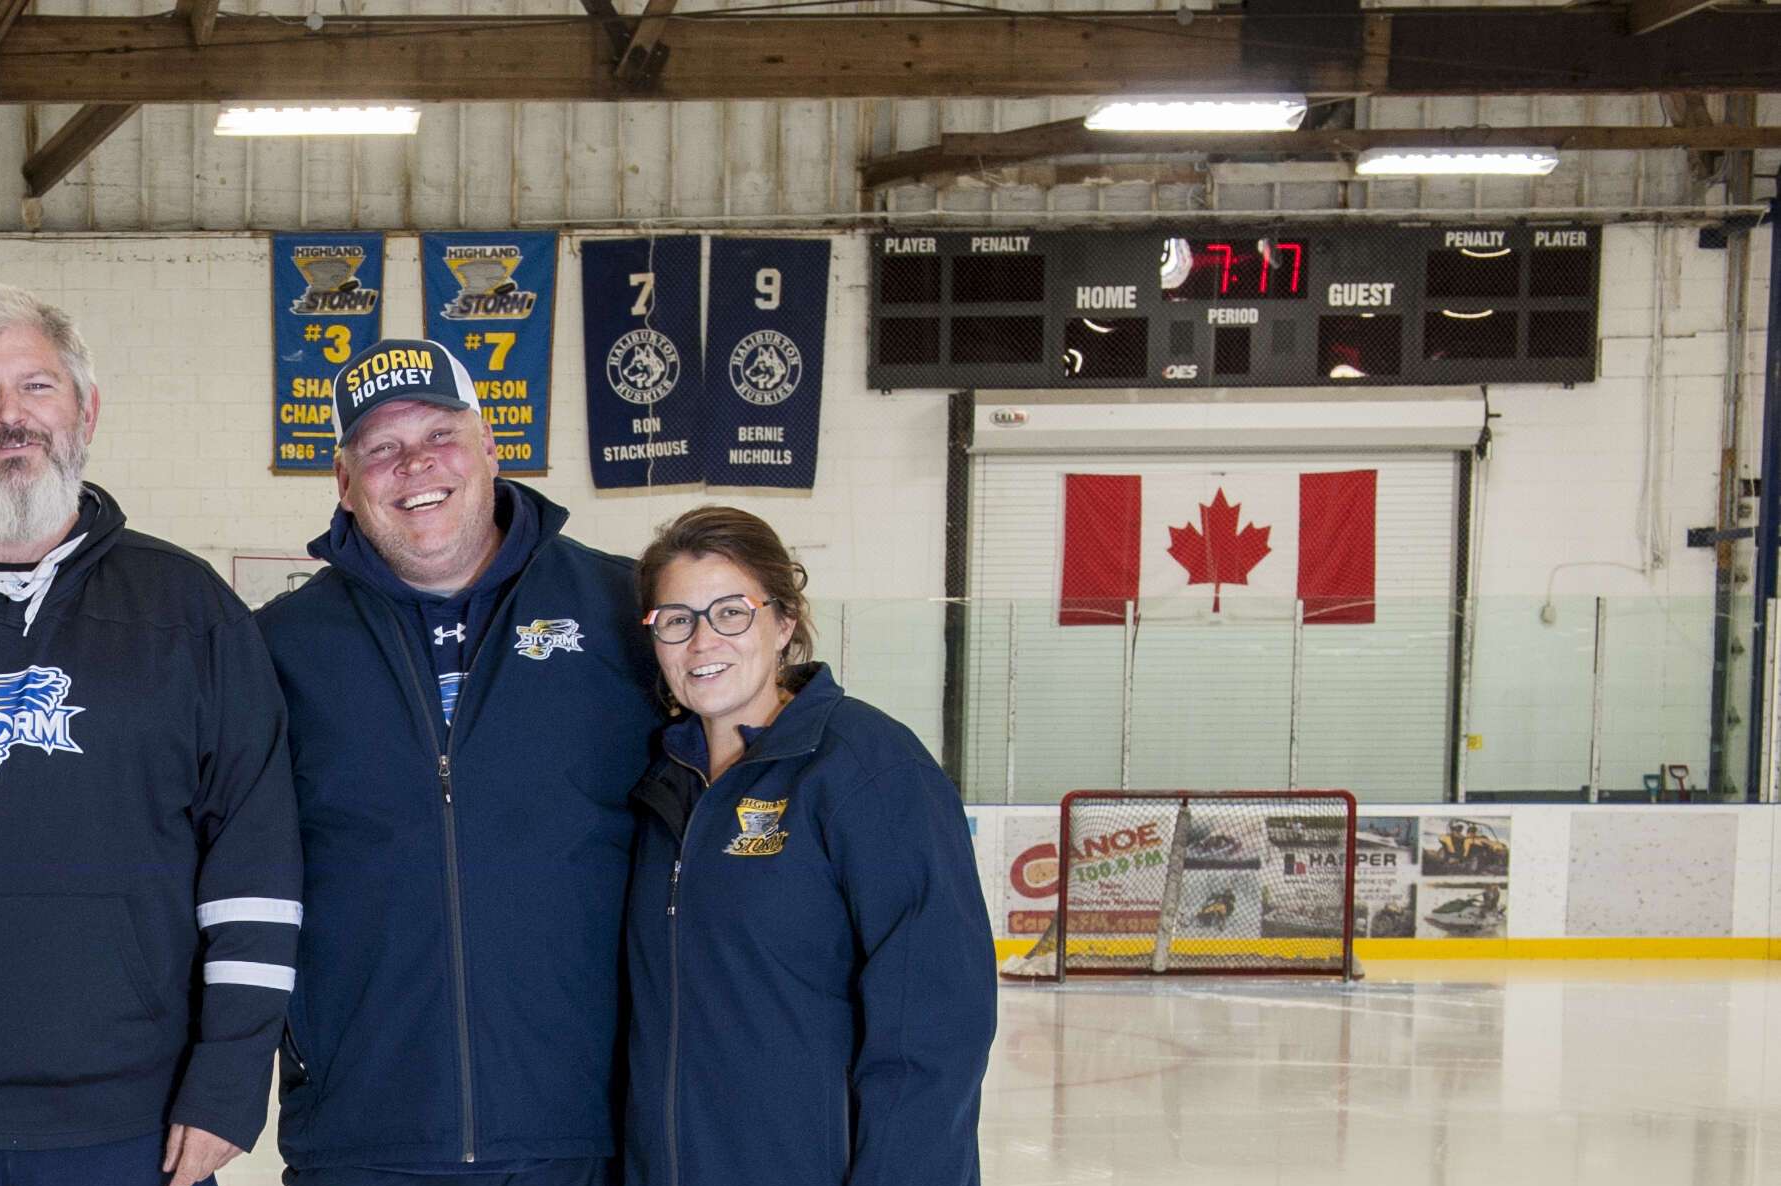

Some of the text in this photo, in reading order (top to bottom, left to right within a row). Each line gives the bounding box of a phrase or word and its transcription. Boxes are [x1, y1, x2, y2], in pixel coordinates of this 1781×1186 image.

[885, 238, 937, 253] PLAYER
[971, 237, 1031, 253] PENALTY
[1445, 231, 1506, 247] PENALTY
[1534, 231, 1587, 247] PLAYER
[294, 246, 363, 258] HIGHLAND
[448, 247, 518, 259] HIGHLAND
[1206, 244, 1302, 294] 7:17
[629, 272, 655, 315] 7
[754, 268, 782, 310] 9
[1076, 286, 1137, 309] HOME
[1328, 283, 1395, 307] GUEST
[306, 291, 371, 311] STORM
[457, 294, 526, 314] STORM
[1207, 308, 1259, 325] PERIOD
[304, 324, 352, 364] #3
[465, 332, 516, 371] #7
[609, 330, 678, 367] HALIBURTON
[732, 332, 800, 367] HALIBURTON
[346, 350, 434, 392] STORM
[292, 378, 333, 398] SHA
[351, 368, 433, 408] HOCKEY
[475, 380, 527, 399] WSON
[616, 380, 673, 403] HUSKIES
[737, 381, 793, 404] HUSKIES
[280, 404, 332, 424] CHAP
[482, 406, 533, 425] ILTON
[633, 417, 661, 434] RON
[738, 426, 785, 443] BERNIE
[280, 444, 315, 460] 1986
[496, 444, 532, 460] 2010
[603, 440, 689, 462] STACKHOUSE
[729, 449, 793, 465] NICHOLLS
[1309, 853, 1397, 867] HAPER
